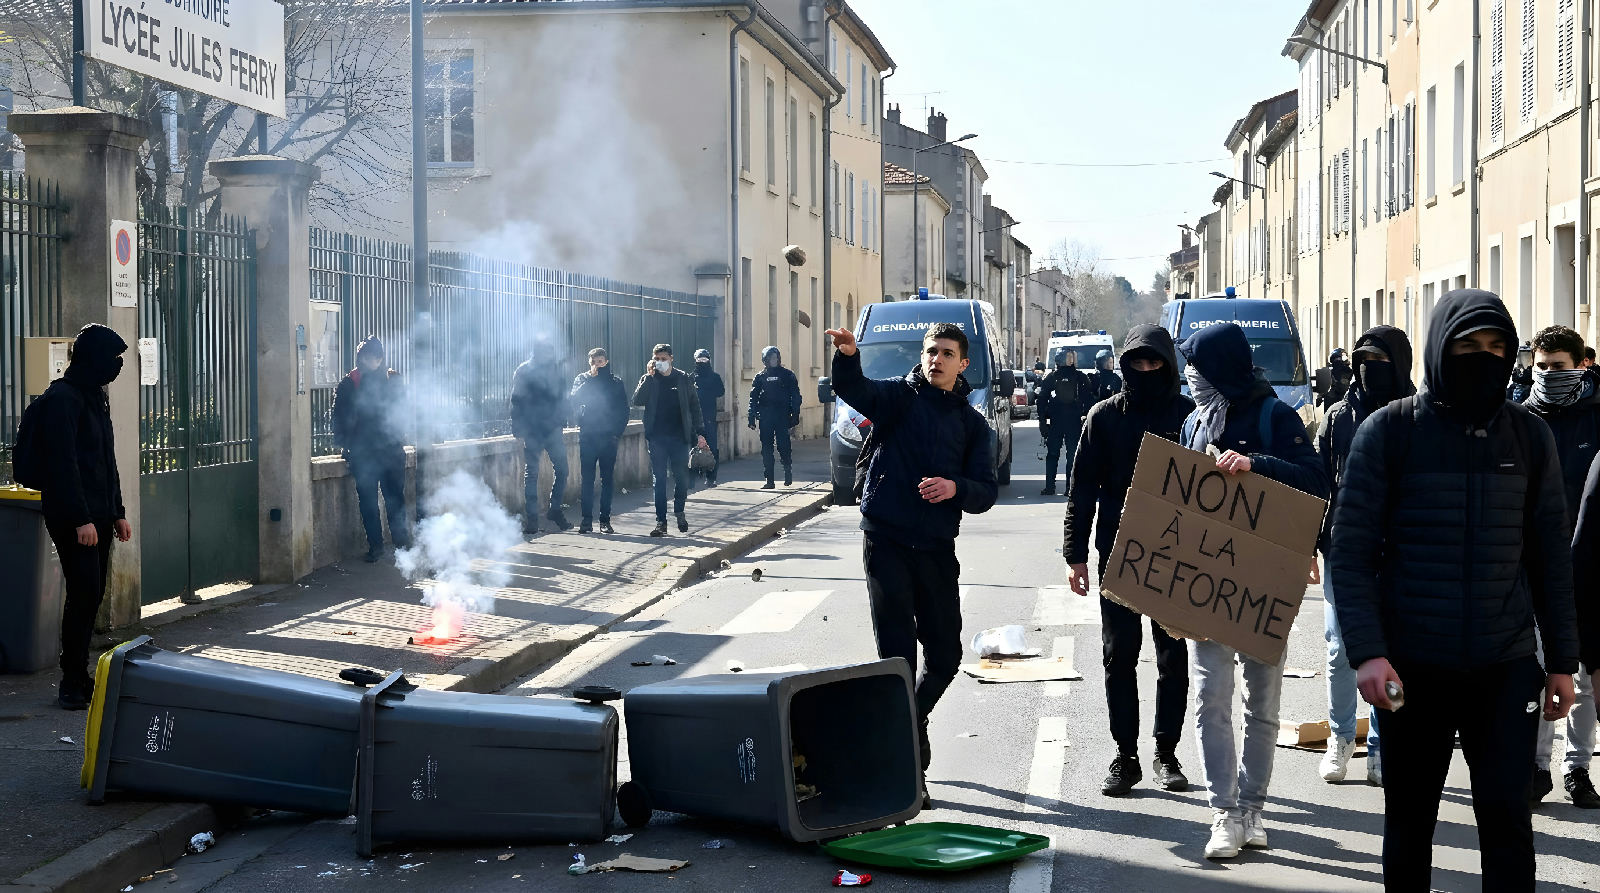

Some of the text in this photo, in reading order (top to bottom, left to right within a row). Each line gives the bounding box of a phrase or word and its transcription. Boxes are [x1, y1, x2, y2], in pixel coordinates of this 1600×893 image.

[102, 0, 277, 101] LYCÉE JULES FERRY
[1161, 456, 1266, 531] NON
[1160, 509, 1236, 567] À LA
[1118, 539, 1295, 640] RÉFORME
